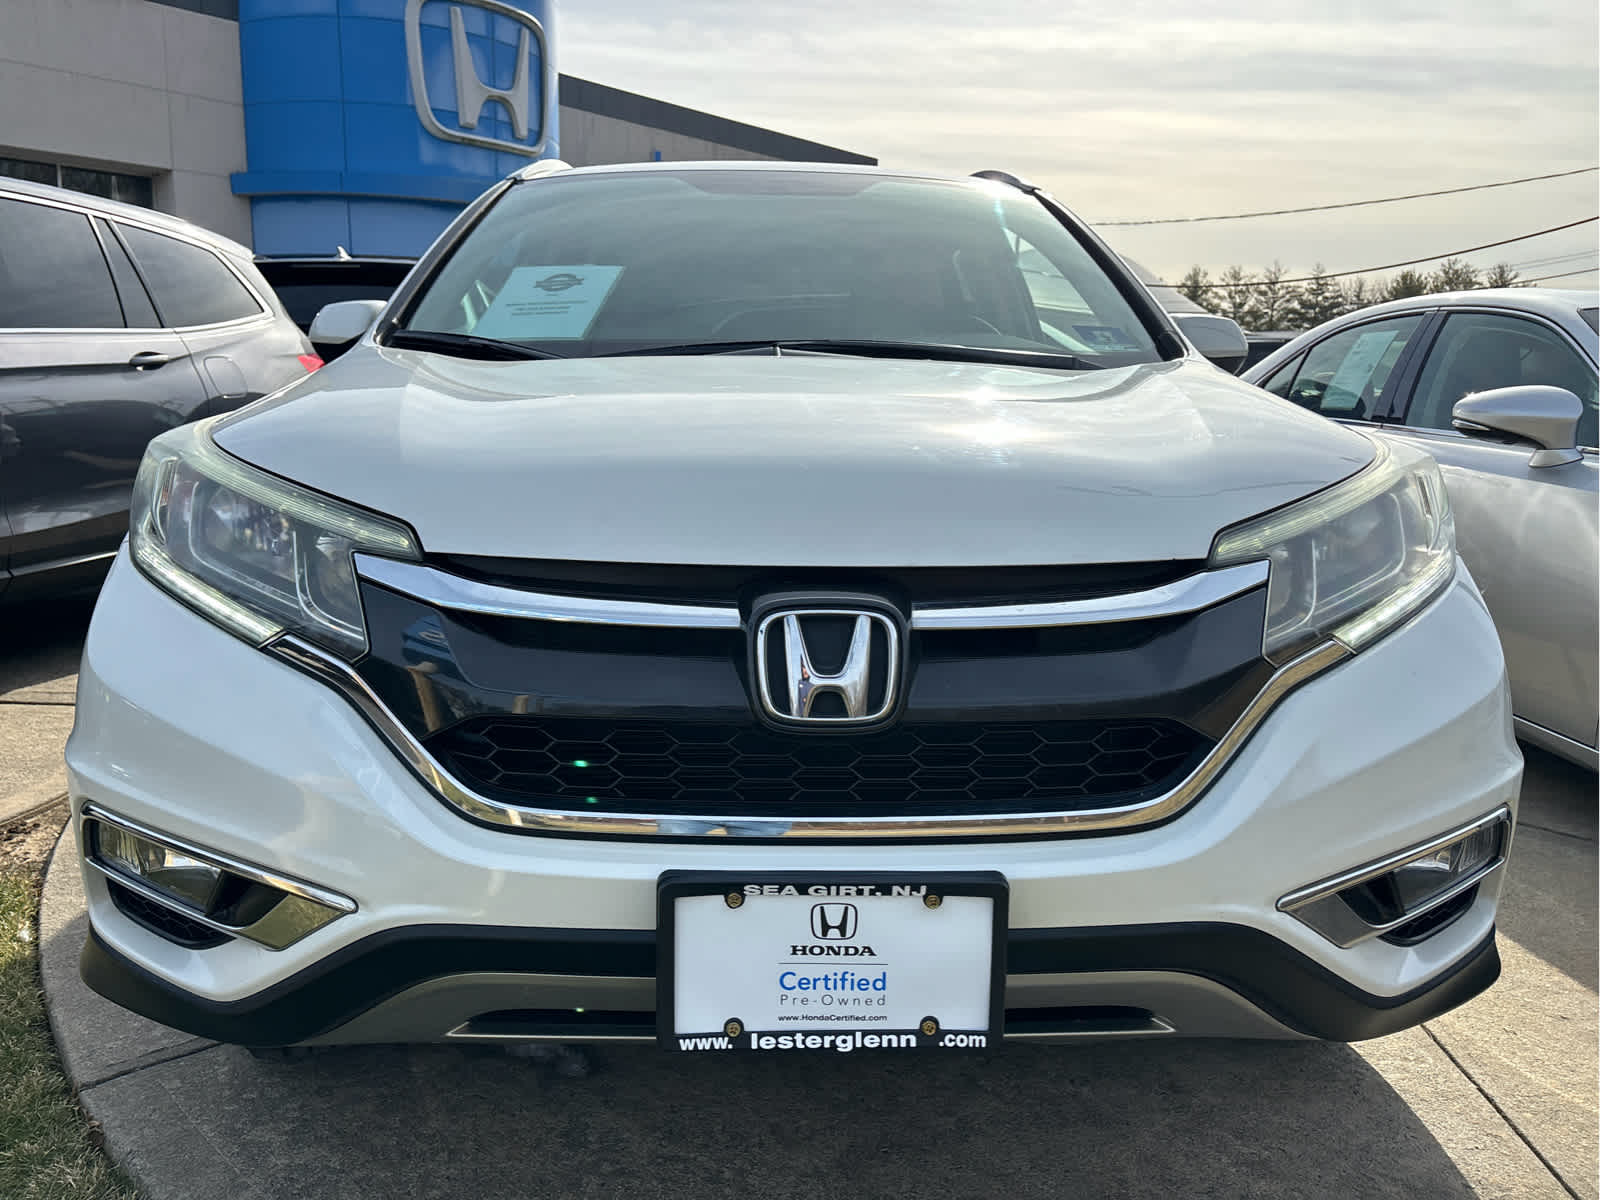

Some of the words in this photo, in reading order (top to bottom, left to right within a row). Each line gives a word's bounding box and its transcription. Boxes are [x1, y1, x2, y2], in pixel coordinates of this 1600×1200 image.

[743, 884, 796, 897] SEA
[892, 886, 927, 897] NJ
[790, 945, 877, 957] HONDA
[779, 971, 887, 991] Certified
[780, 994, 886, 1006] Pre-Owned
[778, 1014, 887, 1022] www.HondaCertified.com
[679, 1036, 733, 1050] www.
[751, 1032, 916, 1052] lesterglenn
[938, 1033, 987, 1048] .com
